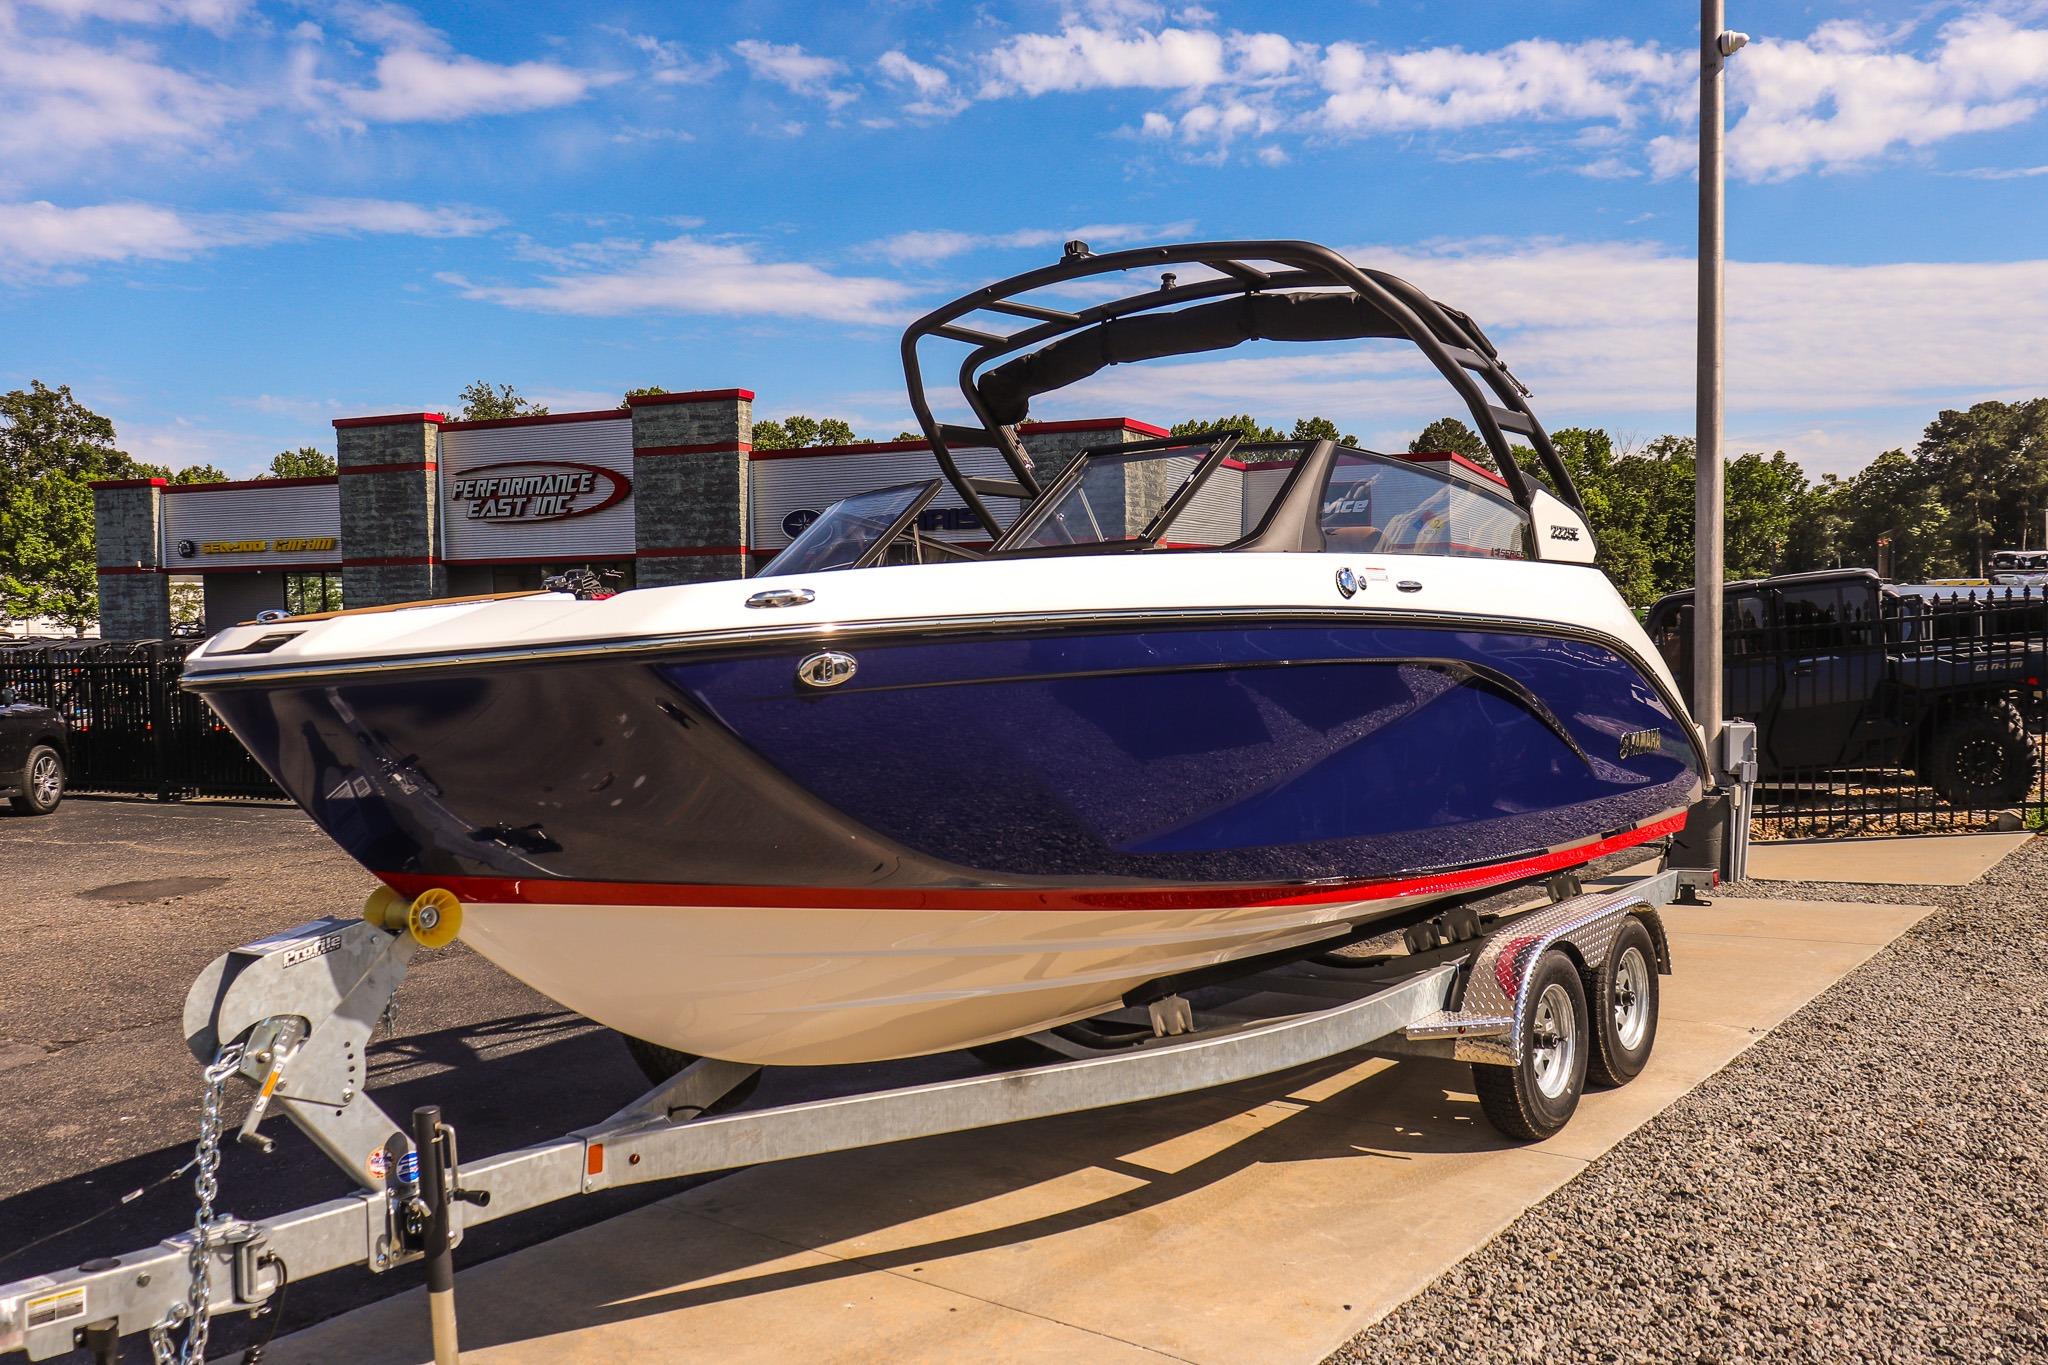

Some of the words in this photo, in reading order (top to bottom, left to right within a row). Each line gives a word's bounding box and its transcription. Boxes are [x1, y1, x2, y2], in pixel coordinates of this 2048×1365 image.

[451, 472, 594, 499] PERFORMANCE
[467, 497, 527, 518] EAST
[533, 495, 571, 515] INC
[283, 935, 342, 964] Profile
